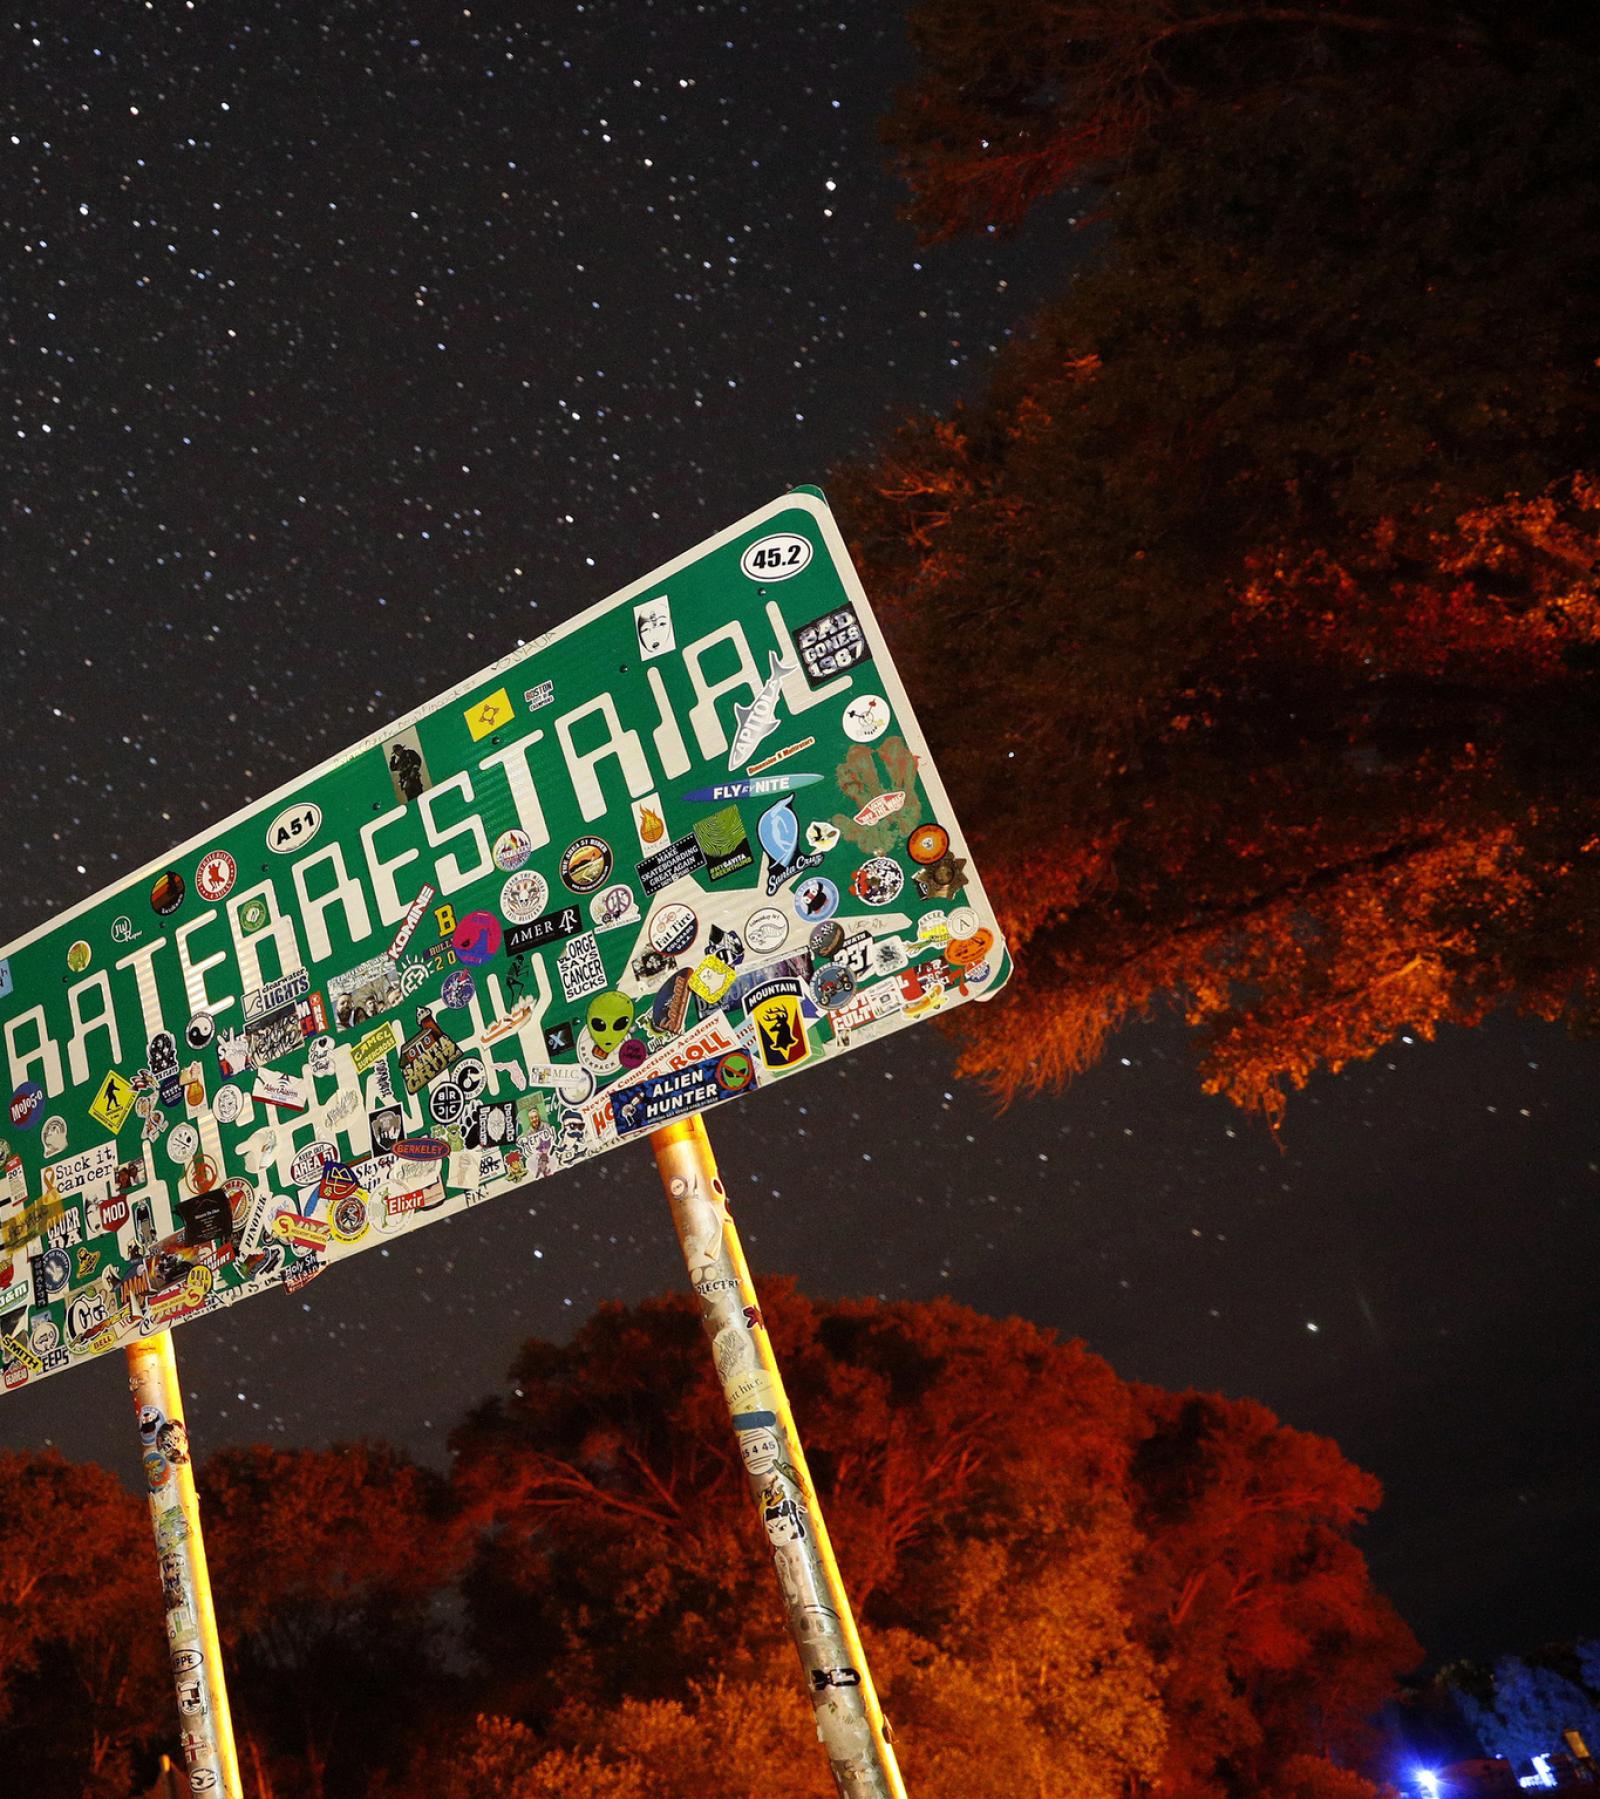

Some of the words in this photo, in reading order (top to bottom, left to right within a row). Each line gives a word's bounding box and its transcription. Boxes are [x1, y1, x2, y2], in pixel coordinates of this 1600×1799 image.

[753, 545, 801, 569] 45.2
[801, 611, 854, 648] BAD
[803, 627, 859, 663] GONES
[808, 642, 863, 679] 1987
[713, 784, 743, 800] FLY
[755, 777, 790, 794] NITE
[276, 811, 314, 845] A51
[640, 845, 699, 881] SKATEBOARDING
[649, 868, 675, 887] GREAT
[673, 856, 696, 874] AGAIN
[768, 864, 799, 896] Santa
[796, 853, 824, 871] Cruz
[388, 884, 435, 959] KOMINE
[434, 904, 457, 937] B
[510, 920, 554, 946] AMER
[655, 931, 673, 950] Fat
[673, 912, 692, 935] Tire
[667, 924, 695, 953] COLORADO
[560, 950, 599, 972] SAYS
[562, 960, 602, 989] CANCER
[262, 966, 308, 992] clearwater
[263, 974, 309, 1008] LIGHTS
[567, 974, 606, 998] SUCKS
[749, 981, 797, 1006] MOUNTAIN
[354, 1031, 391, 1060] CAMEL
[357, 1038, 395, 1072] SUPERCROSS
[580, 1046, 615, 1070] BACKPACK
[669, 1031, 732, 1072] ROLL
[582, 1089, 615, 1114] Nevada
[616, 1047, 675, 1090] Connections
[677, 1017, 720, 1048] Academy
[652, 1069, 704, 1098] ALIEN
[646, 1083, 718, 1118] HUNTER
[293, 1156, 321, 1176] AREA
[322, 1149, 336, 1166] 51
[398, 1144, 443, 1155] BERKELEY
[55, 1156, 92, 1180] Suck
[56, 1163, 114, 1193] cancer
[102, 1201, 126, 1223] MOD
[387, 1193, 423, 1213] Elixir
[245, 1195, 267, 1247] PINOTEK
[2, 1335, 40, 1370] SMITH
